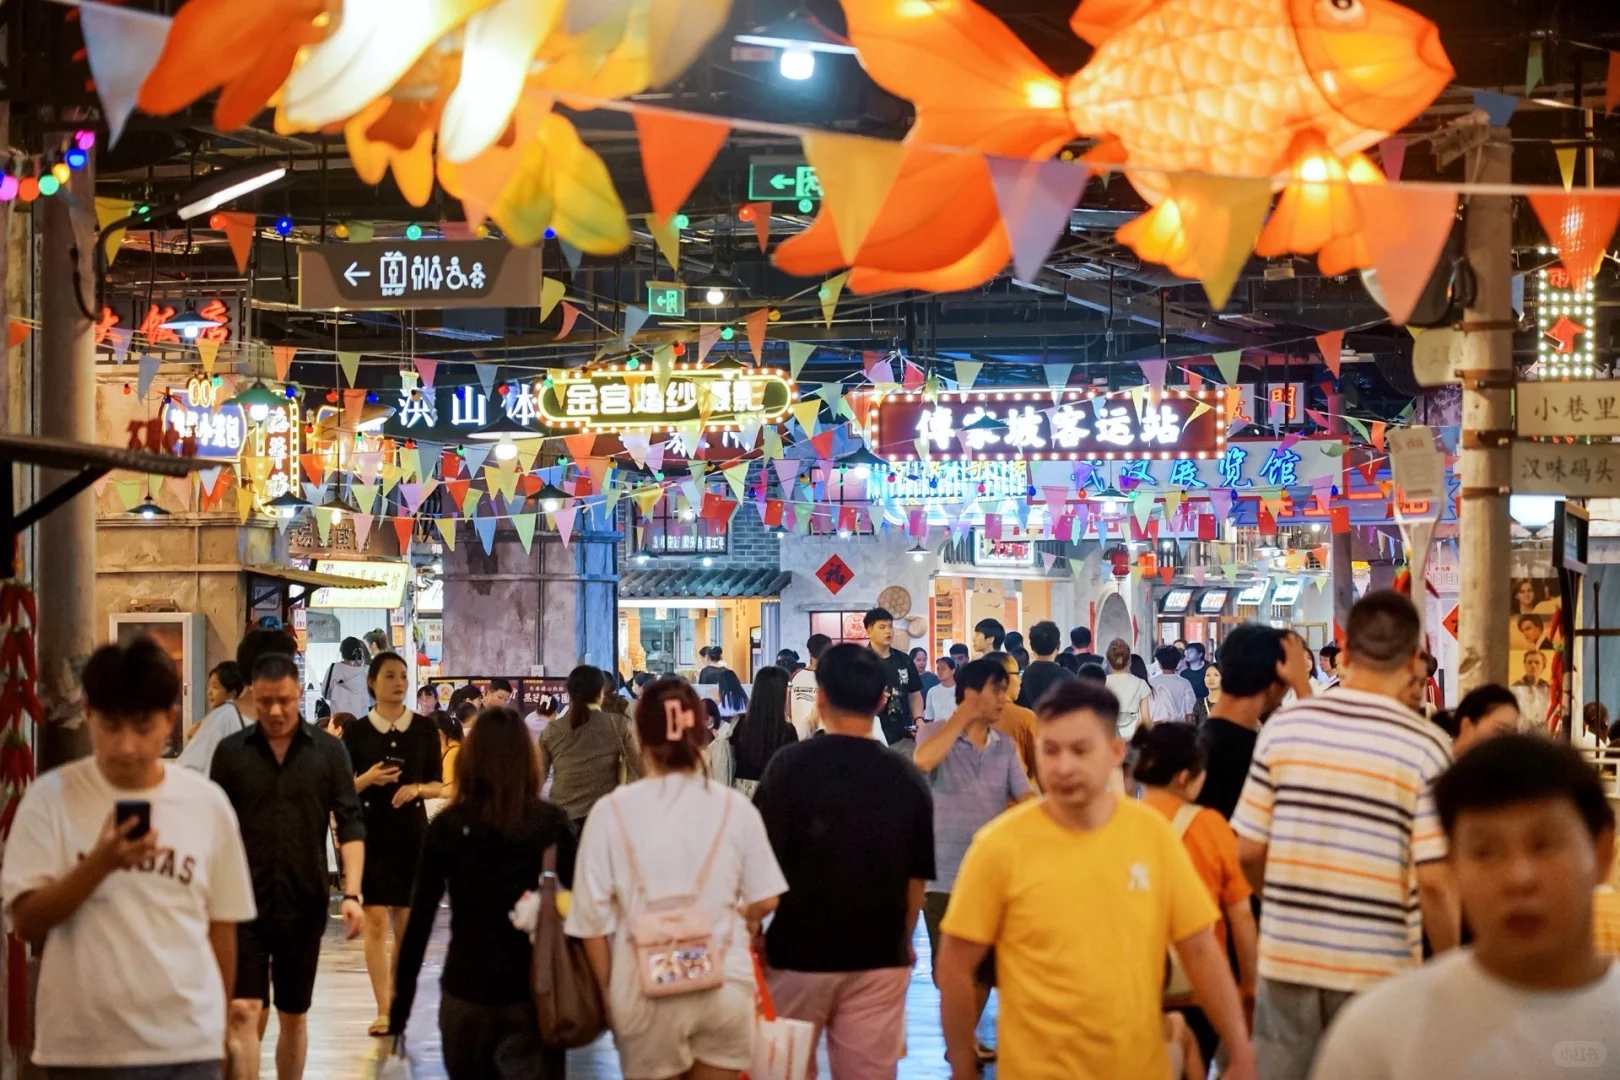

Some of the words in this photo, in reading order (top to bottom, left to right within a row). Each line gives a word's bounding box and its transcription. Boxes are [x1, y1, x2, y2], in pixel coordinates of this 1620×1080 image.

[1533, 394, 1619, 422] 小巷里
[1521, 455, 1614, 484] 汉味码头
